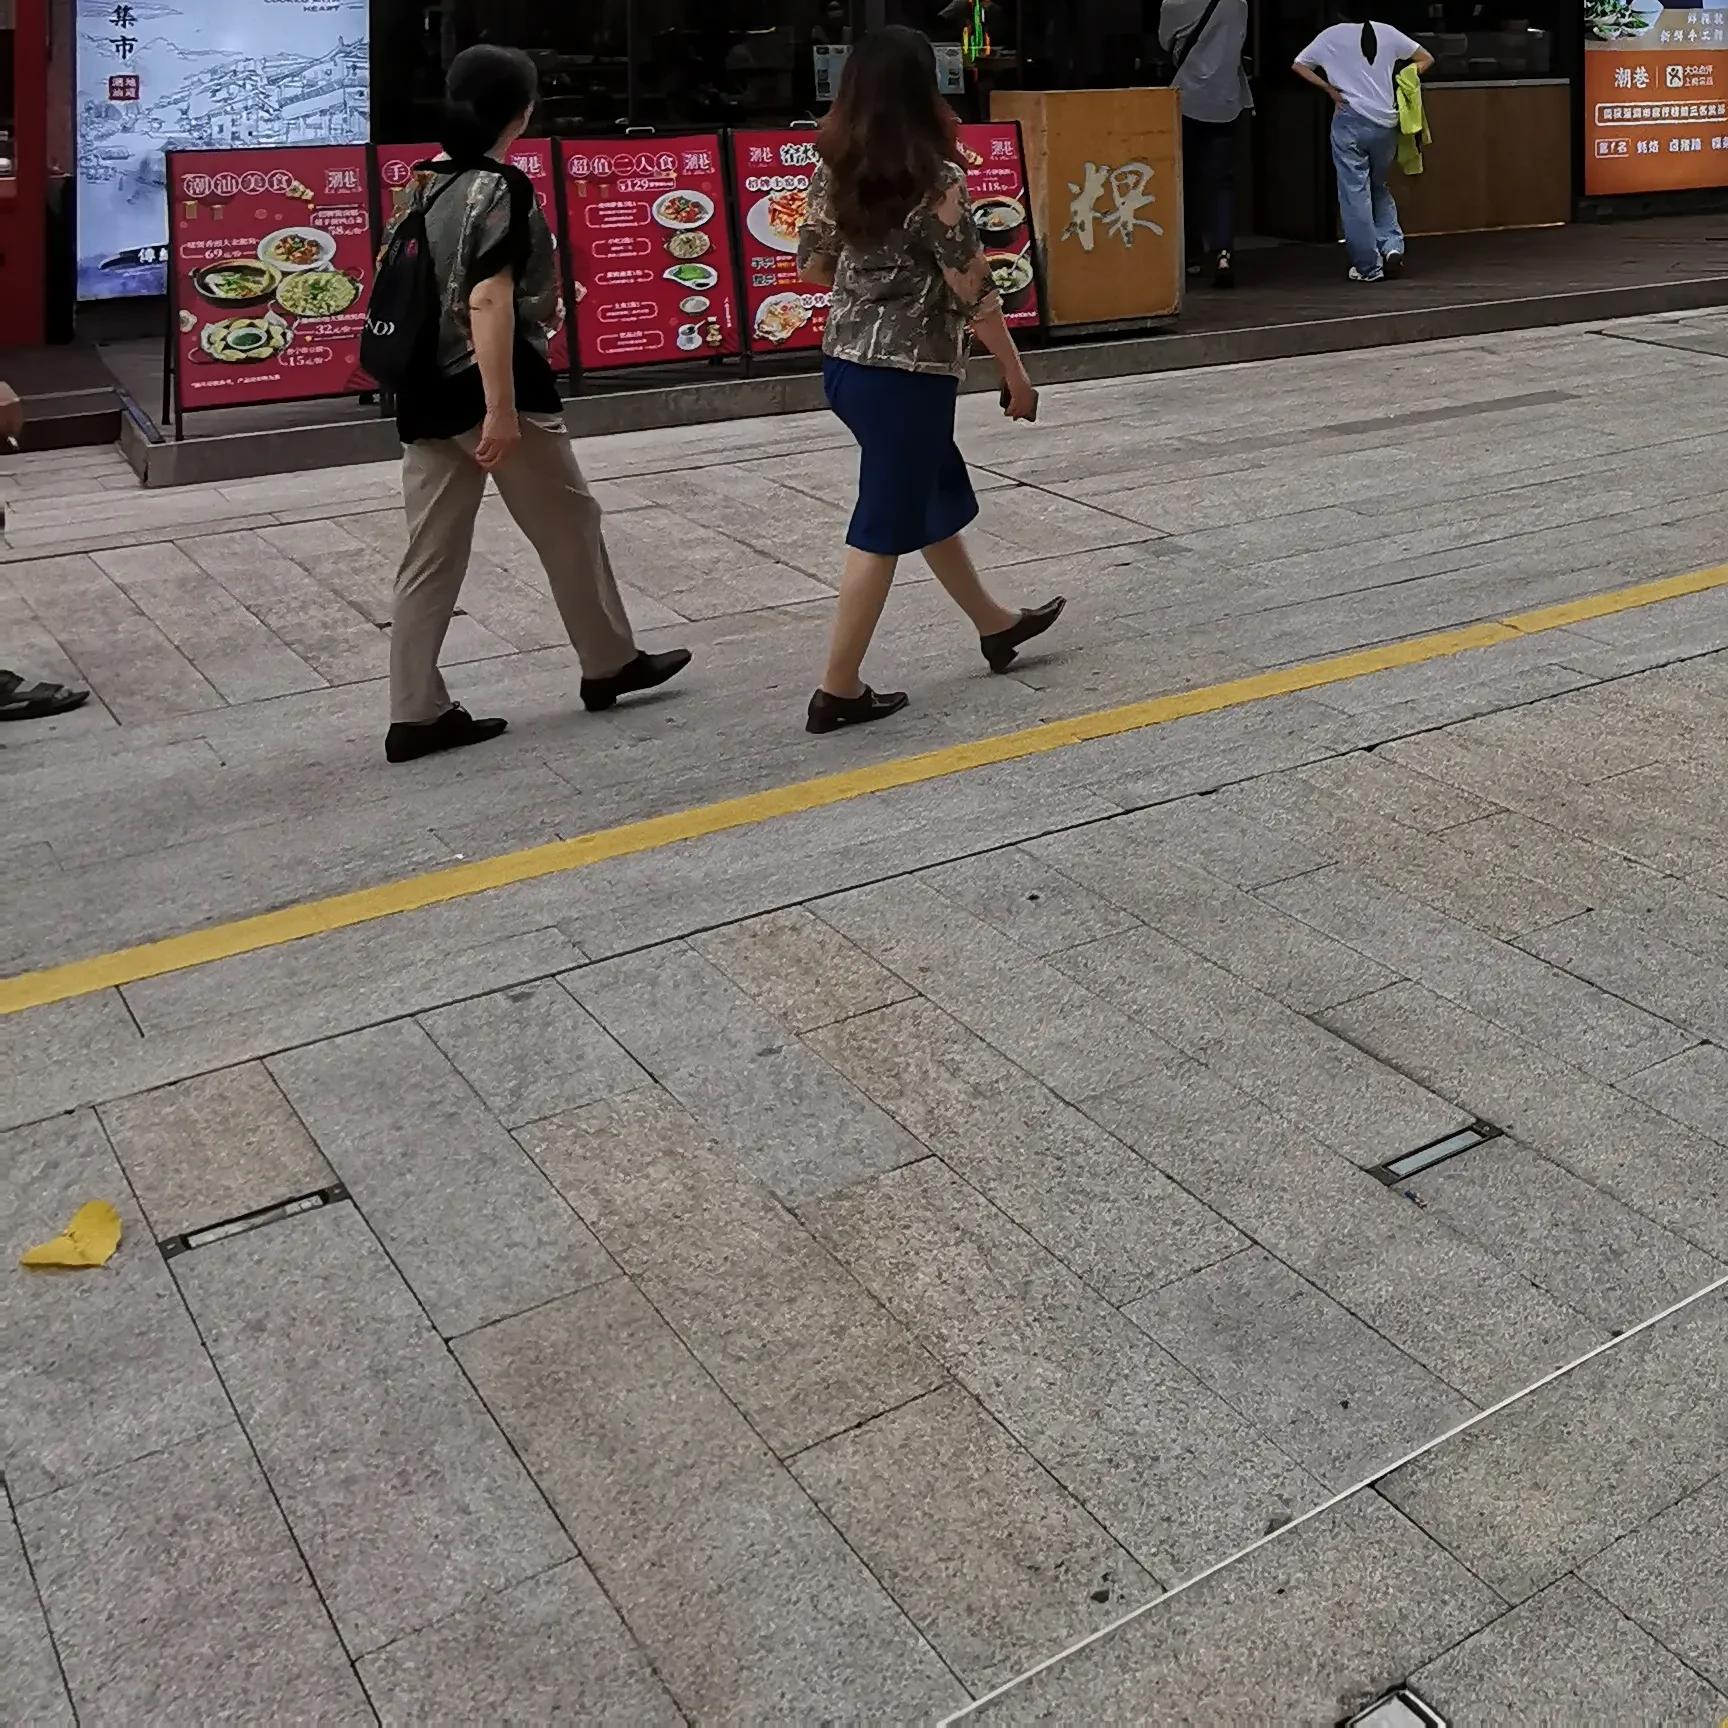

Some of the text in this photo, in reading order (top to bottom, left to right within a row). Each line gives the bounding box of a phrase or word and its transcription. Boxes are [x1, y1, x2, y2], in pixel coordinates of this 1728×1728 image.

[1615, 66, 1650, 89] 潮巷
[571, 155, 674, 174] 超值二人食
[187, 173, 290, 195] 潮汕美食
